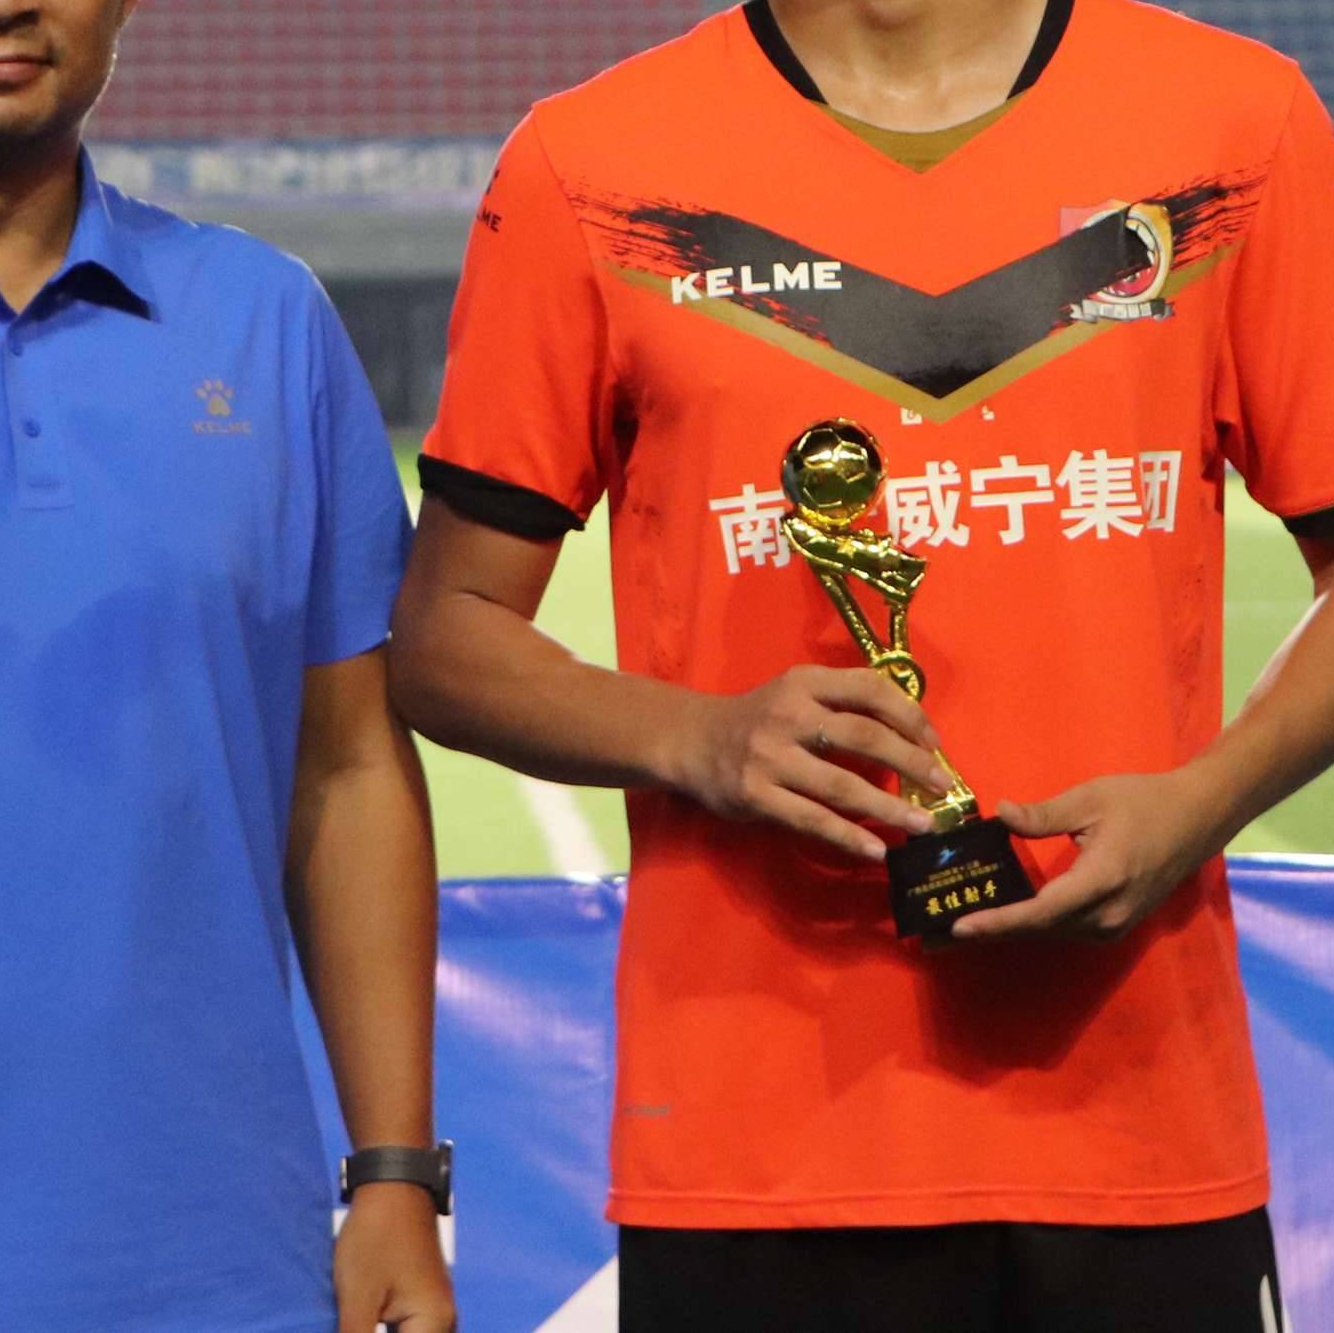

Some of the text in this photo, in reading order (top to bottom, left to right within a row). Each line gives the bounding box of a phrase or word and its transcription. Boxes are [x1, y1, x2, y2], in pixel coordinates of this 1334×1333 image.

[671, 261, 842, 305] KELME
[192, 420, 252, 436] KELME
[708, 449, 1183, 575] 南威宁集团
